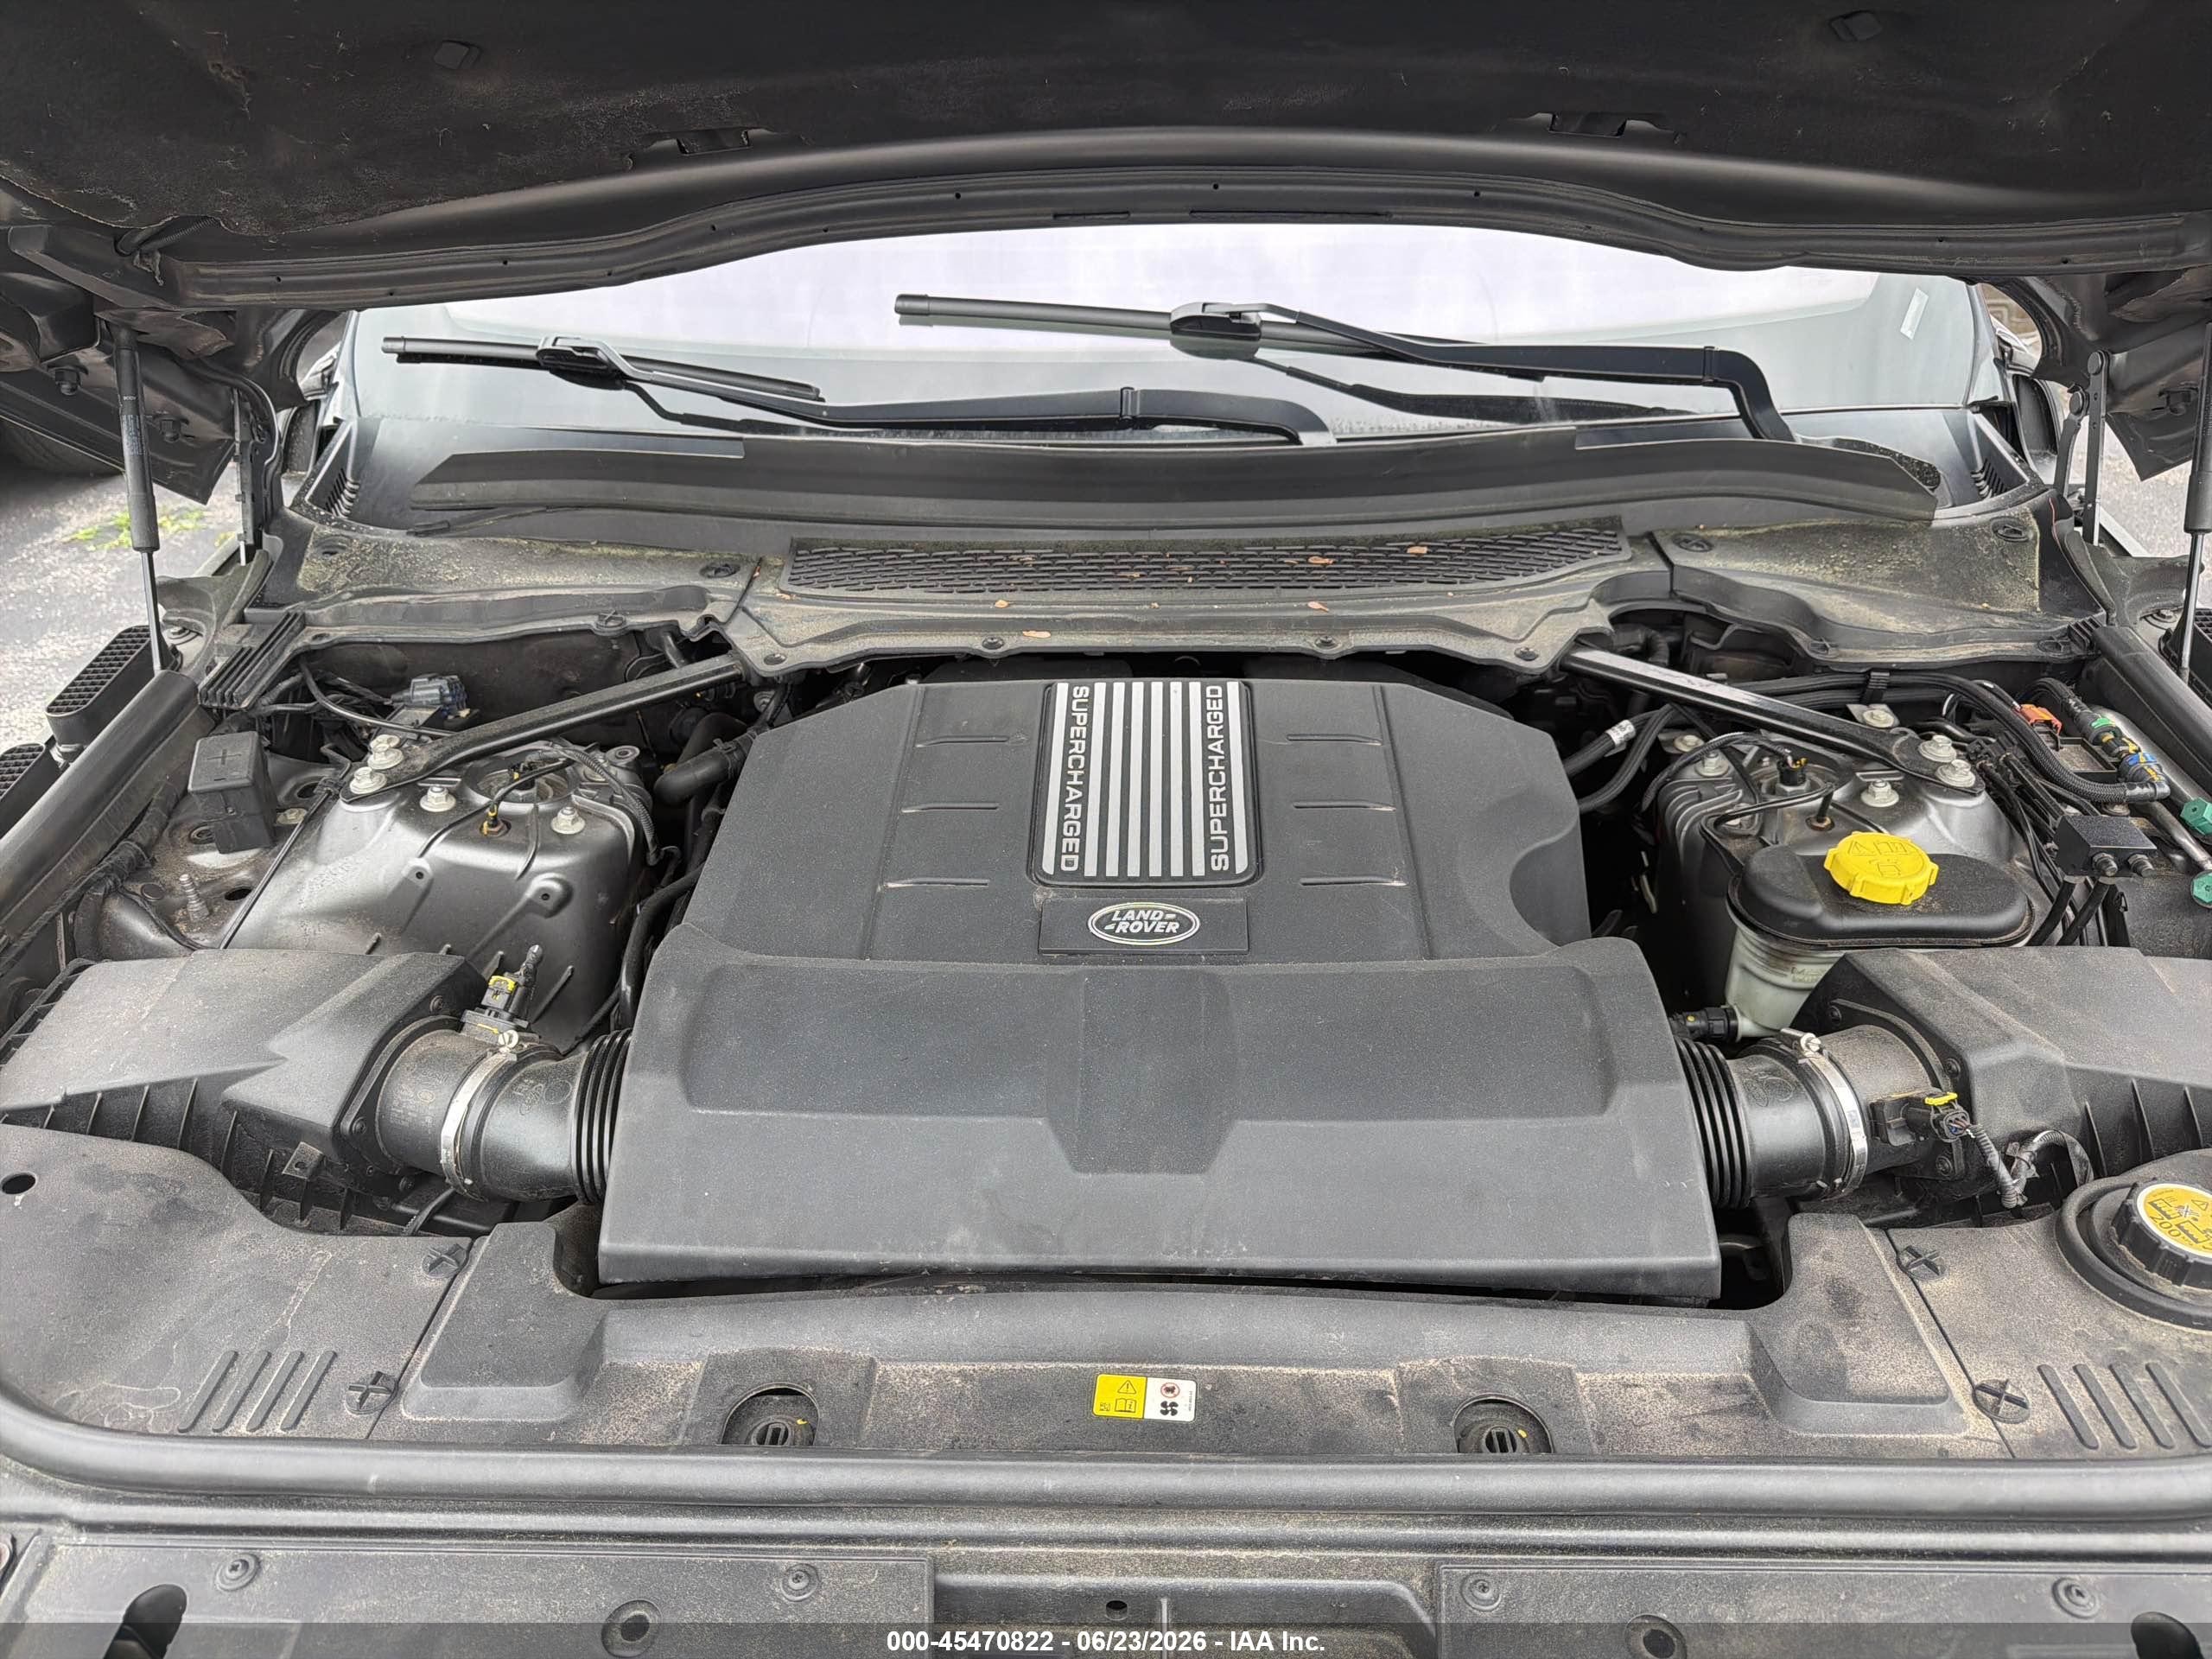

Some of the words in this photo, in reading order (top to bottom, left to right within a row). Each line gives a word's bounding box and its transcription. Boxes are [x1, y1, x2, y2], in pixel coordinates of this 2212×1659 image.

[1060, 685, 1090, 873] SUPERCHARGED
[1205, 684, 1230, 872] SUPERCHARGED
[1111, 909, 1164, 922] LAND
[1115, 920, 1180, 934] ROVER
